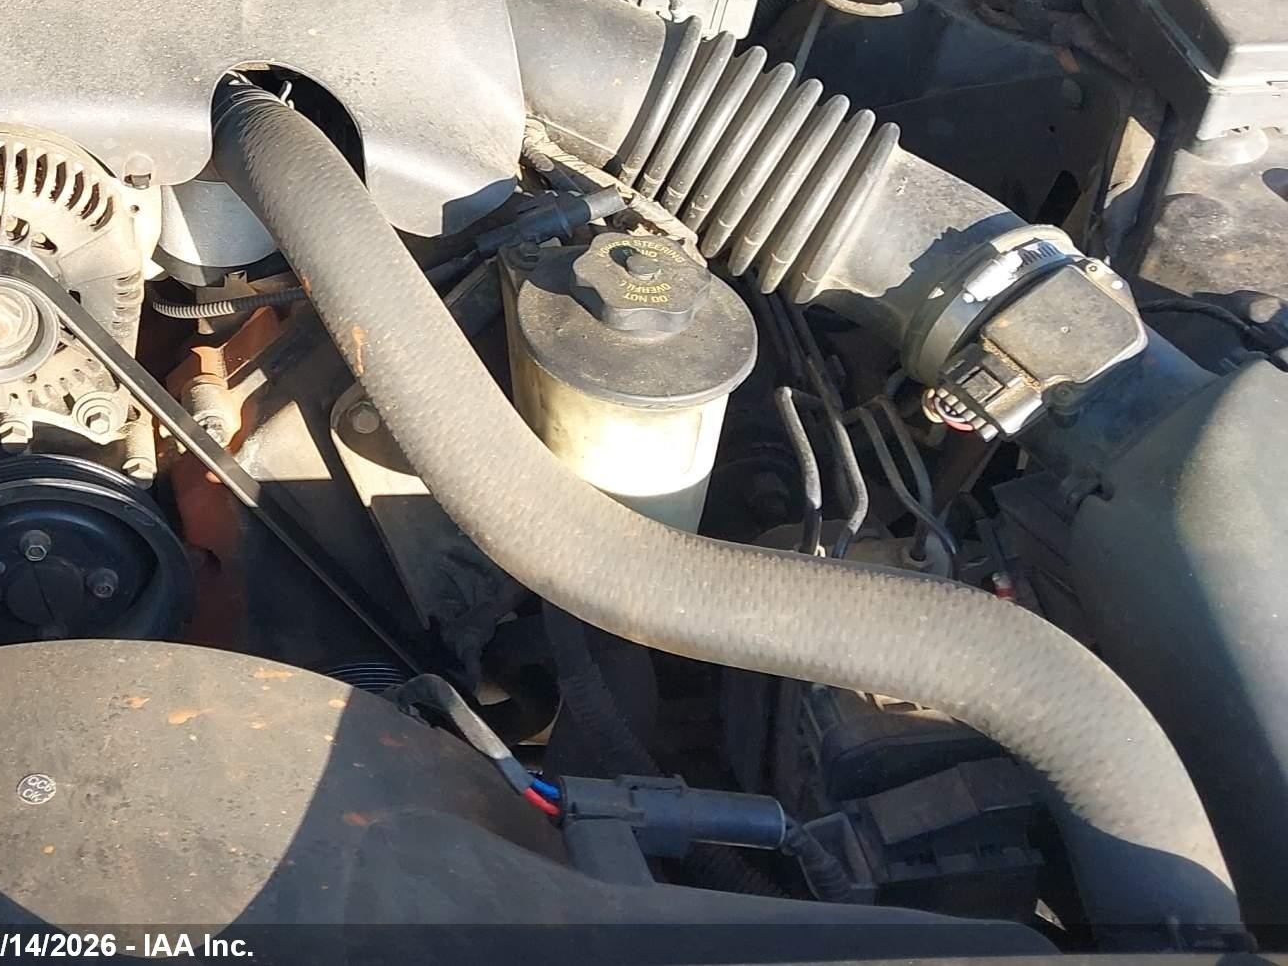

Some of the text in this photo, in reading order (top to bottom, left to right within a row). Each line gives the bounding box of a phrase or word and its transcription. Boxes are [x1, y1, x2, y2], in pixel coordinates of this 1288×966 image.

[632, 239, 685, 263] STEERING
[618, 279, 672, 294] OVERFILL
[623, 292, 669, 303] DO NOT
